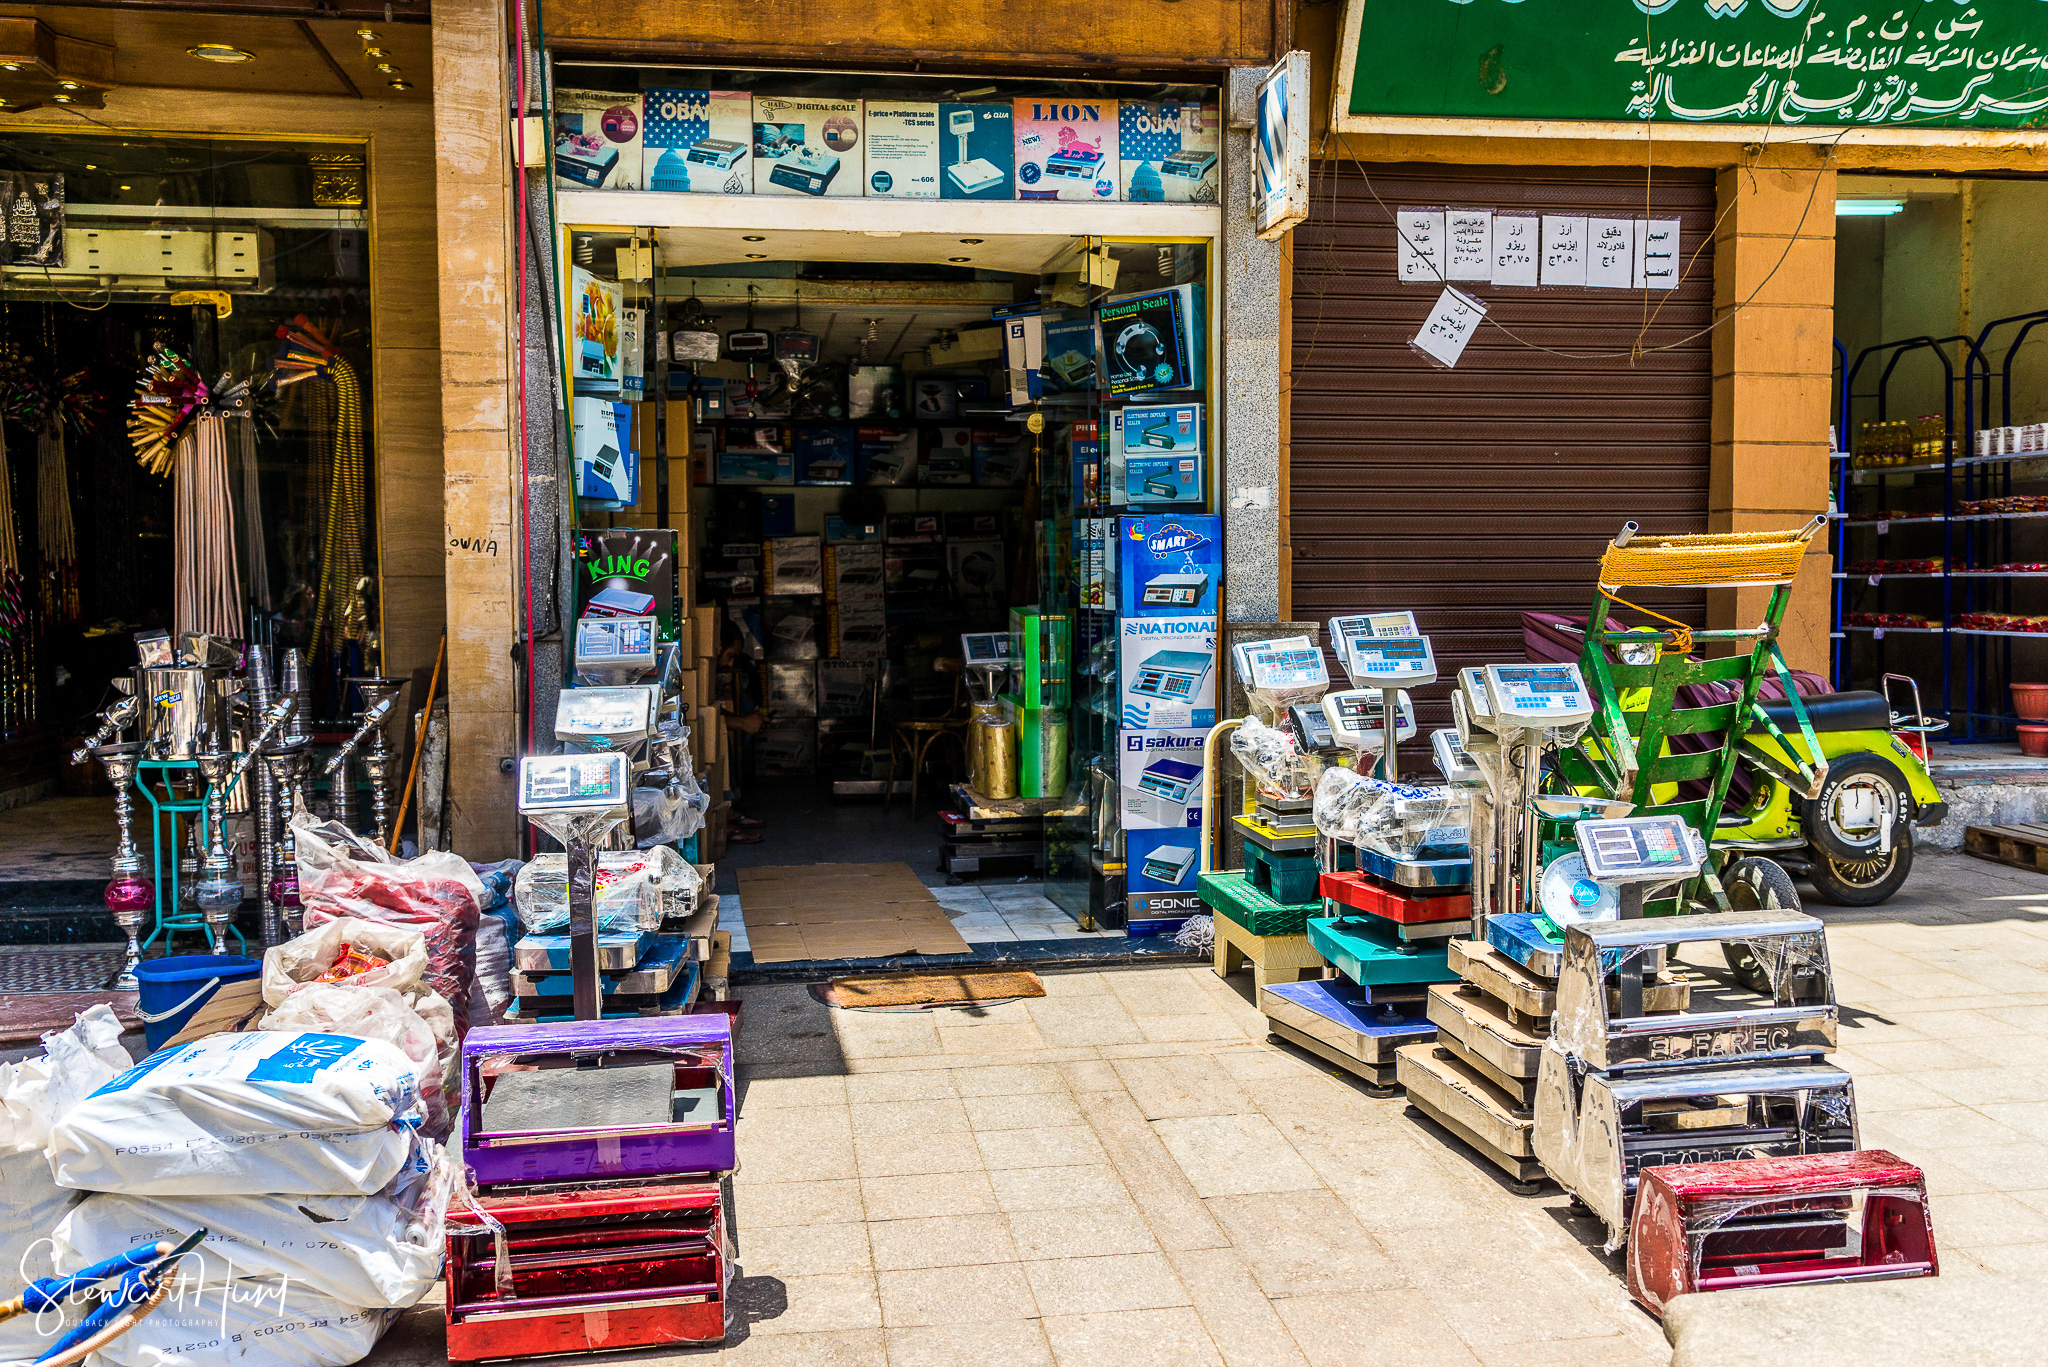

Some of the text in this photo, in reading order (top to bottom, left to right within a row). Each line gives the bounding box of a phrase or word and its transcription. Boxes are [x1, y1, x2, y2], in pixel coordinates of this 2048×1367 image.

[1614, 38, 1715, 73] الغذائية
[1716, 42, 1805, 70] للصناعات
[1806, 44, 1903, 72] القابضة
[1904, 43, 1975, 72] الشركة
[660, 102, 735, 122] OBAMA
[796, 103, 856, 112] DIGITAL SCALE
[1031, 103, 1101, 122] LION
[1022, 135, 1041, 146] NEW!
[1413, 220, 1430, 230] زيت
[1453, 218, 1468, 226] خاص
[1414, 234, 1430, 243] عباد
[1601, 226, 1622, 238] دقيق
[1648, 232, 1669, 241] البيع
[1505, 240, 1526, 251] ريزو
[1411, 247, 1434, 258] شمس
[1101, 296, 1169, 318] Personal Scale
[1150, 536, 1188, 551] SMART
[586, 554, 650, 580] KING
[1138, 621, 1218, 635] NATIONAL
[1145, 735, 1205, 748] sakura
[1820, 781, 1838, 821] SECURA
[1149, 897, 1200, 909] SONIC
